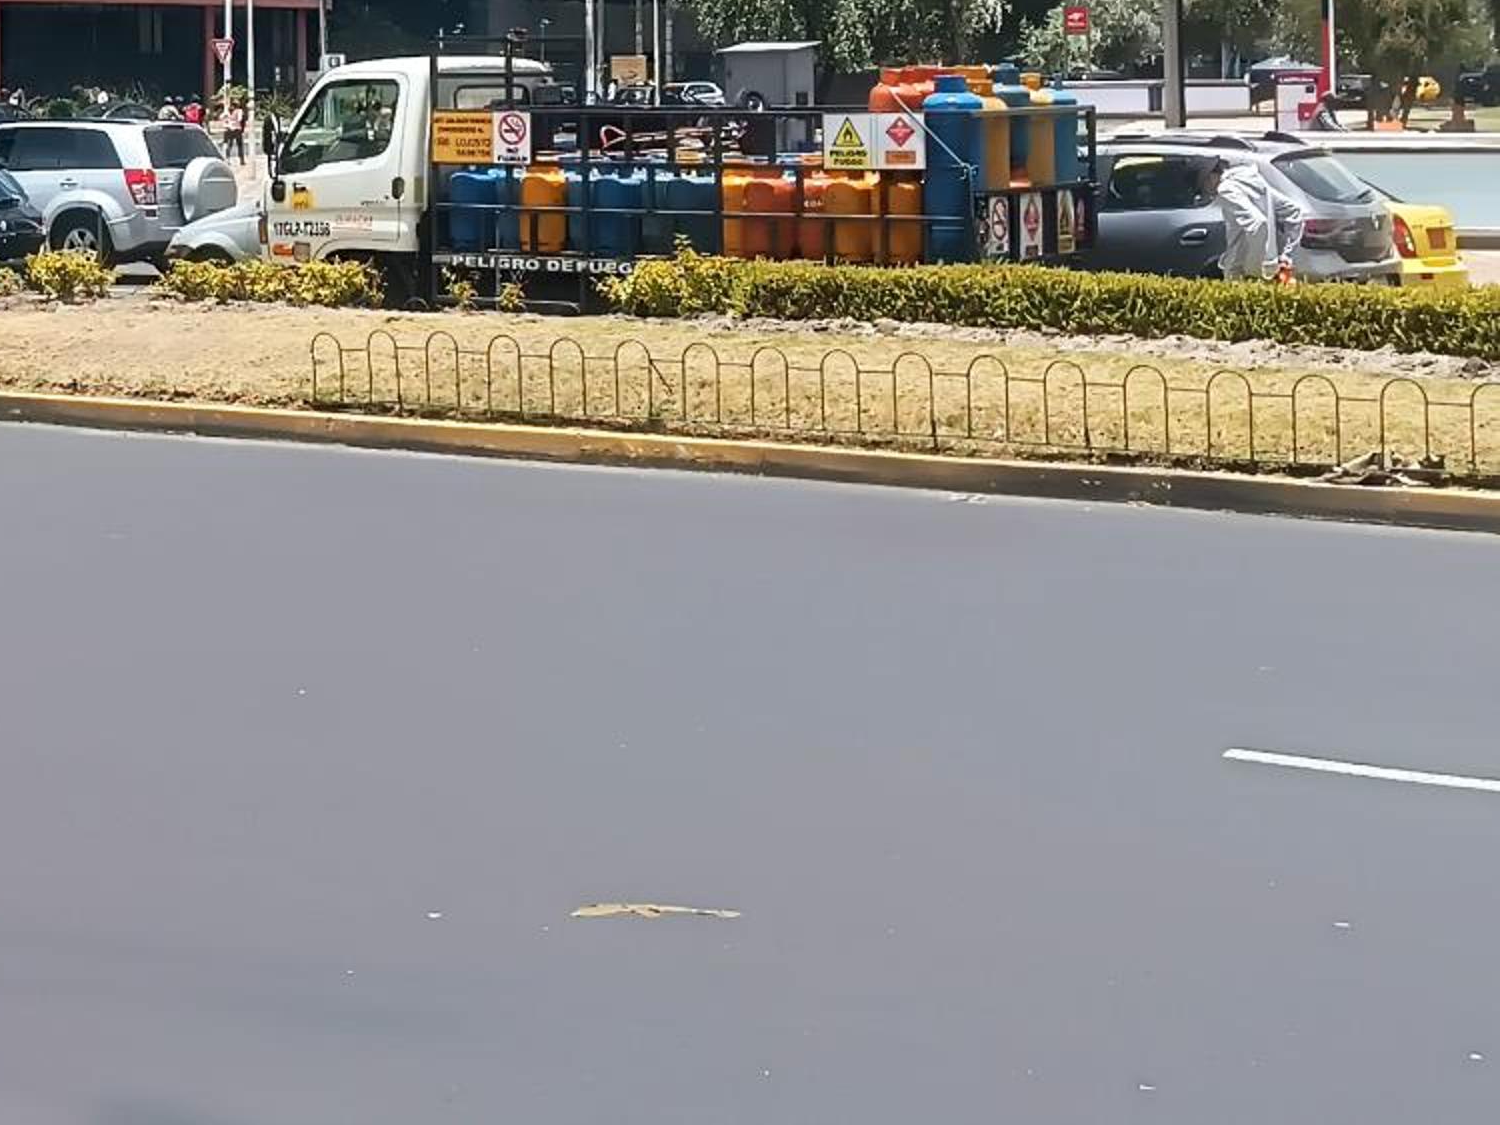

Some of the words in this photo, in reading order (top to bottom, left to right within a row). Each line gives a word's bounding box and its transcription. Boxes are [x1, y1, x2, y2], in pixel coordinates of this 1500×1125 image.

[451, 255, 540, 271] PELIGRO
[546, 260, 573, 272] DE
[575, 261, 633, 274] FUEG
